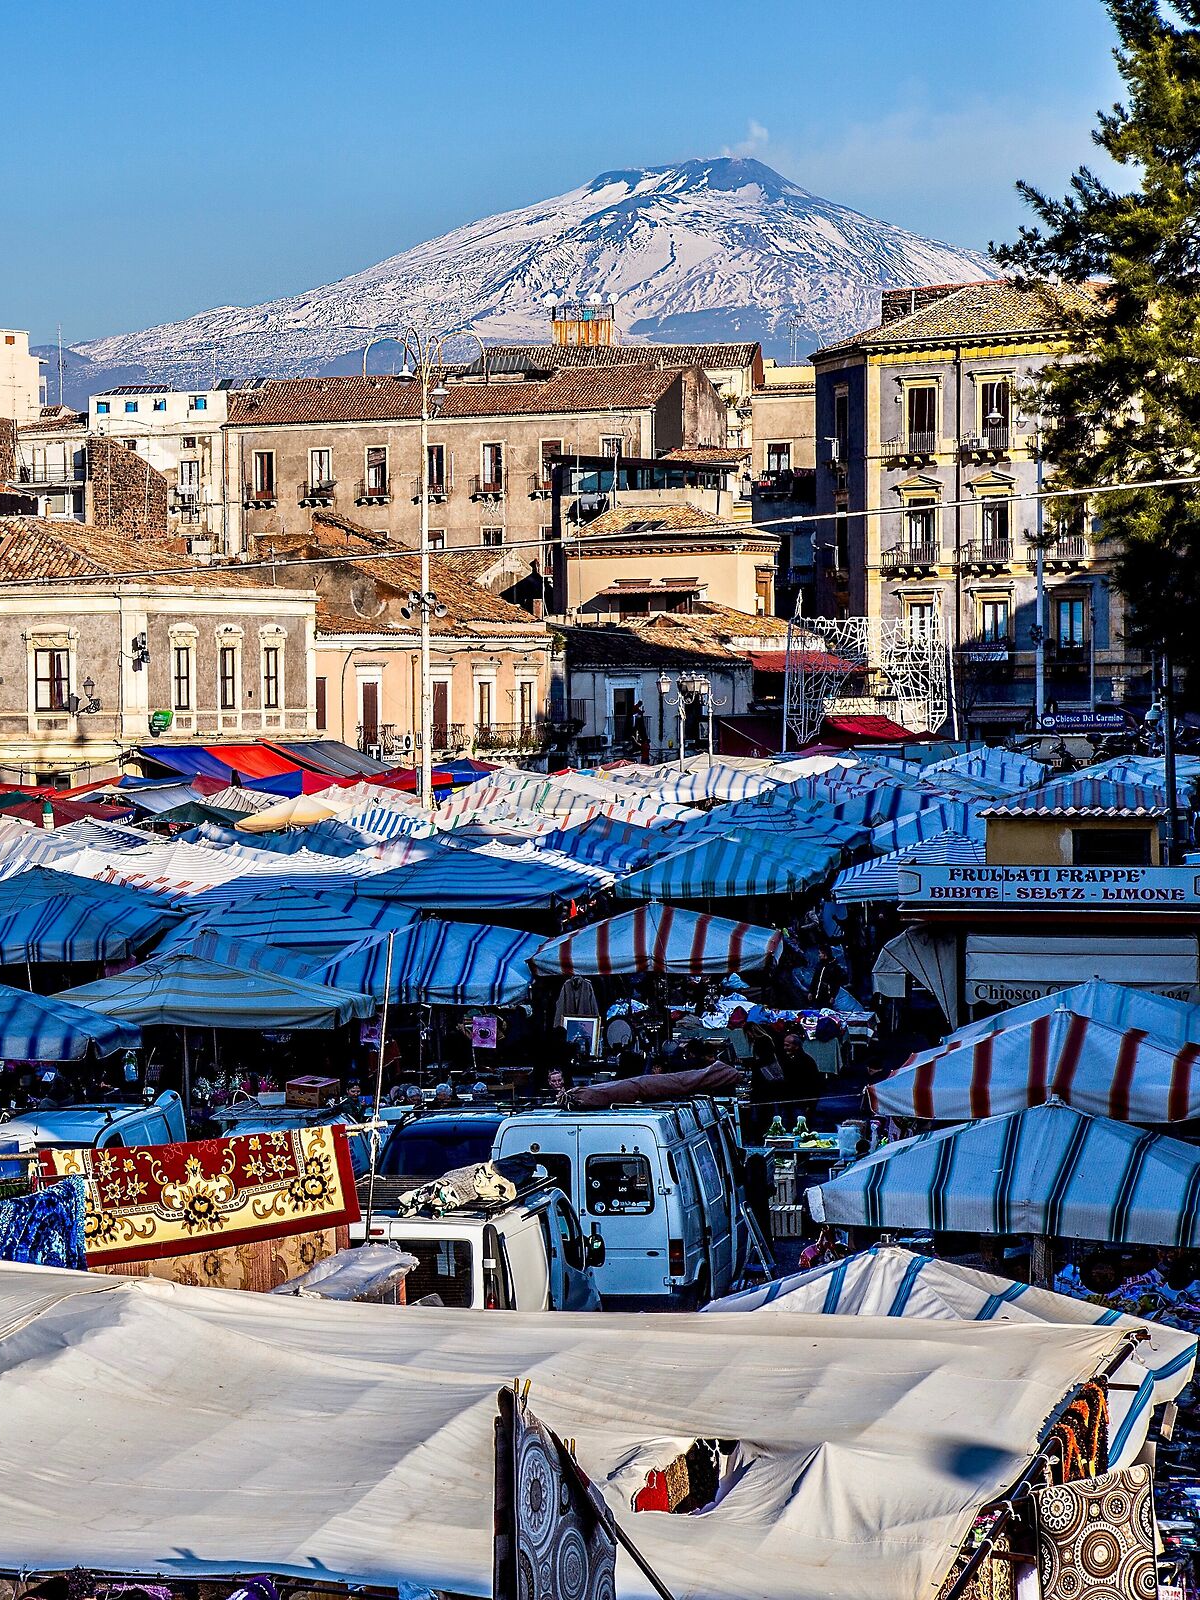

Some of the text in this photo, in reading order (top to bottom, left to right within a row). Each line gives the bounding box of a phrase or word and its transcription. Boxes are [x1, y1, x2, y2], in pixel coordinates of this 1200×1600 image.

[1082, 714, 1094, 722] Del
[949, 868, 1146, 883] FRULLATI FRAPPE'
[929, 886, 1000, 899] BIBITE
[1016, 886, 1085, 900] SELTZ
[1101, 888, 1186, 900] LIMONE
[974, 984, 1041, 1000] Chiosco
